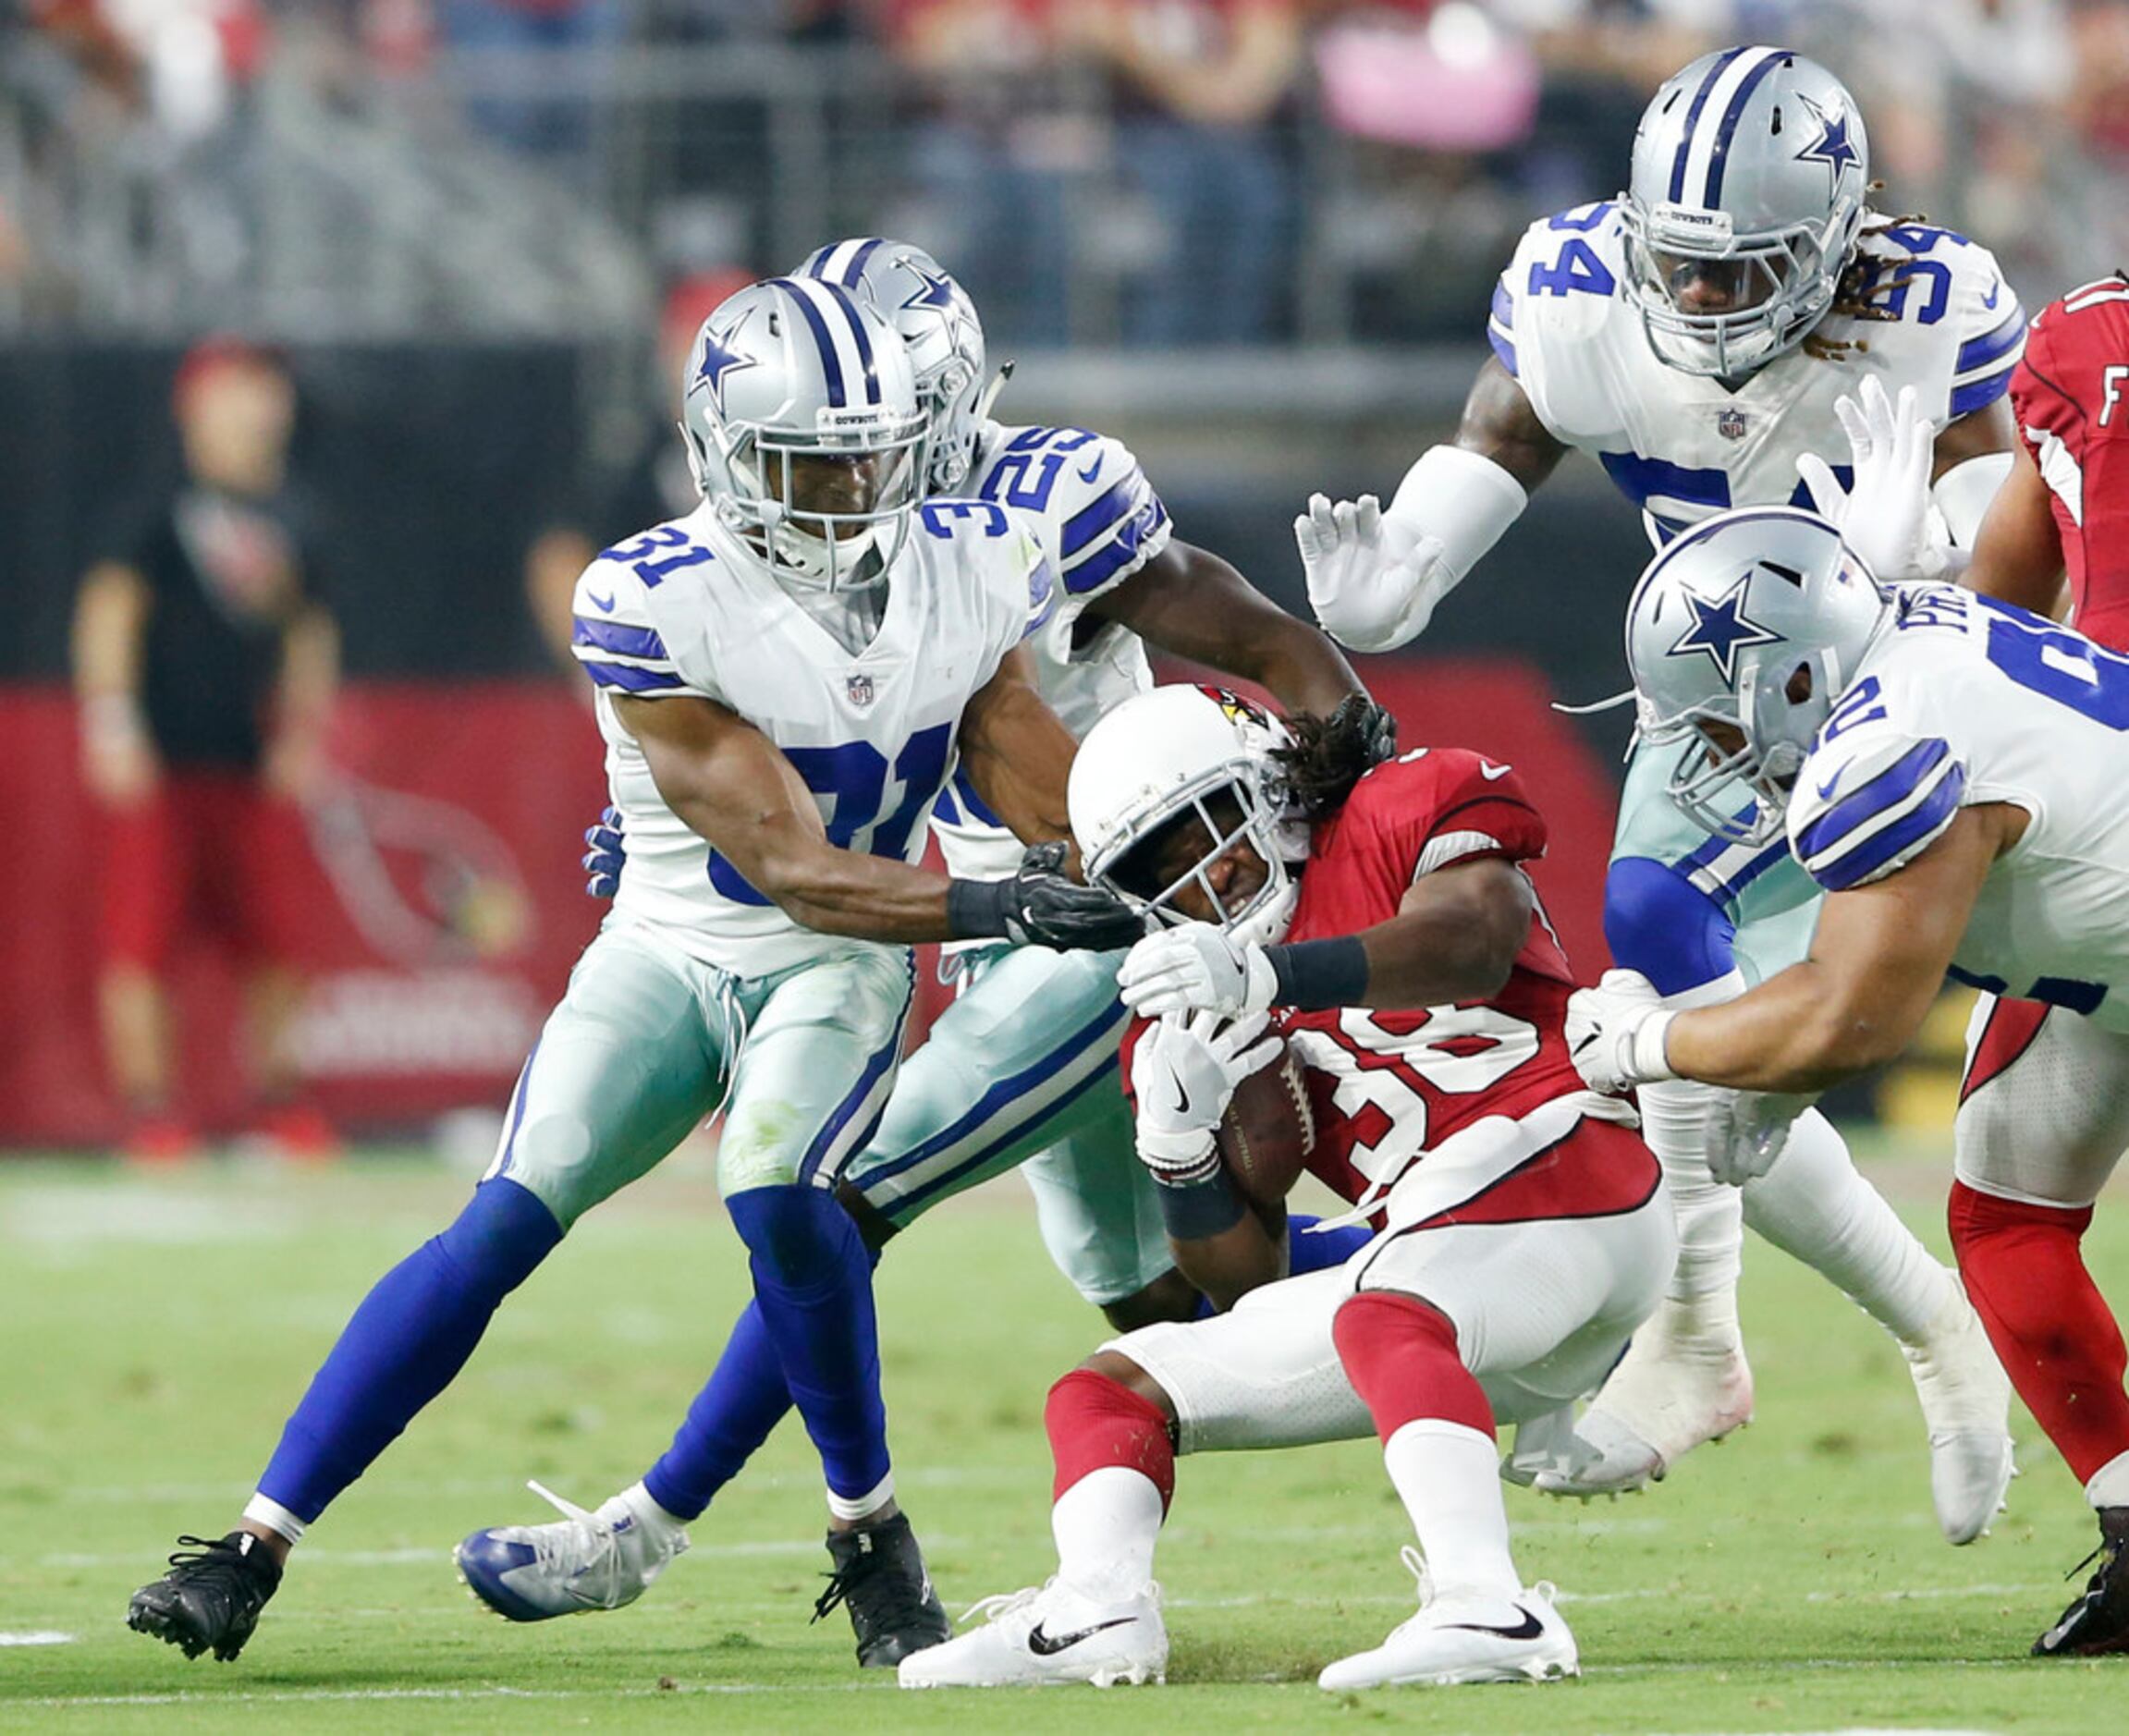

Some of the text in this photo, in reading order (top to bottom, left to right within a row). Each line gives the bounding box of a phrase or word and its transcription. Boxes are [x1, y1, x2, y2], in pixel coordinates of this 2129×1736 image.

[980, 427, 1098, 513] 25
[598, 527, 716, 589] 31
[1292, 1004, 1540, 1187] 38
